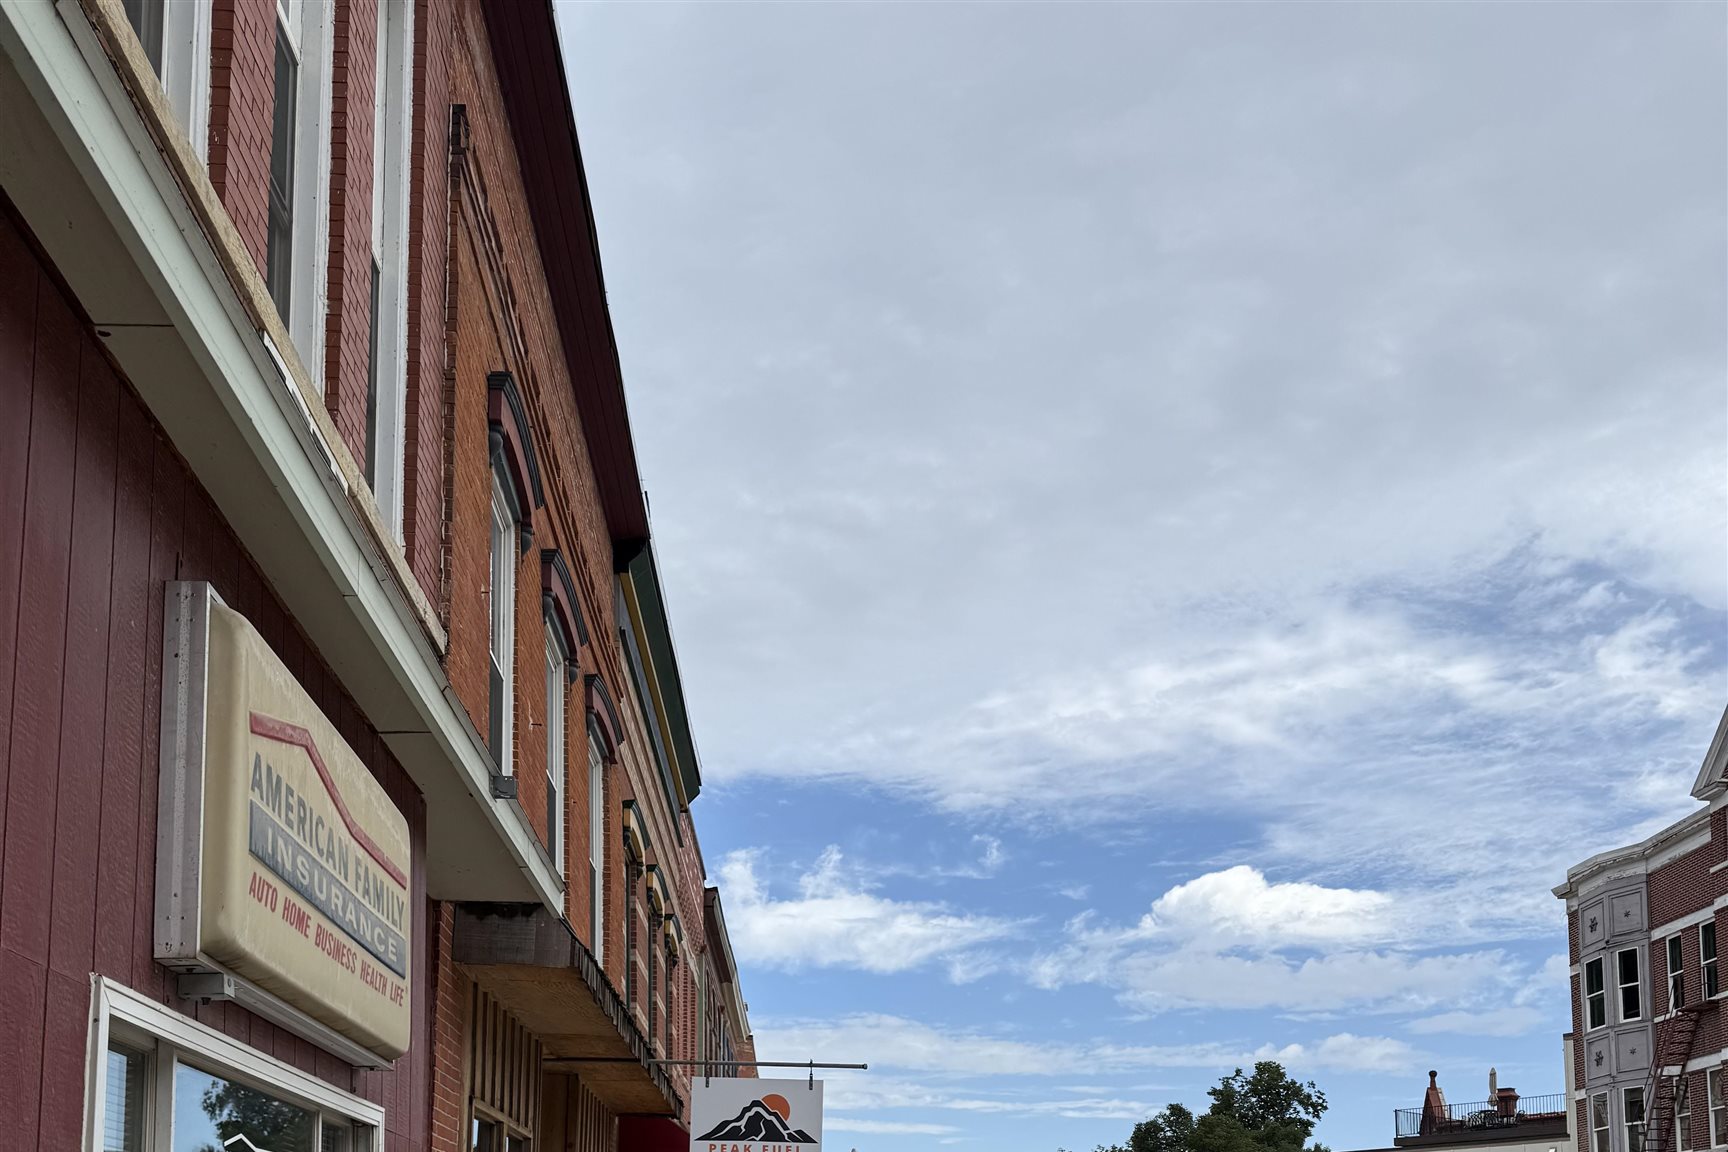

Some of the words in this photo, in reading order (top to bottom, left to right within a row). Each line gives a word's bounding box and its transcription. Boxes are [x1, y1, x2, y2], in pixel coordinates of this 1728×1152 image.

[250, 752, 349, 882] AMERICAN
[354, 856, 405, 932] FAMILY
[266, 826, 398, 963] INSURANCE
[249, 871, 278, 913] AUTO
[282, 896, 312, 939] HOME
[314, 923, 358, 975] BUSINESS
[360, 958, 388, 997] HEALTH
[390, 981, 405, 1007] LIFE
